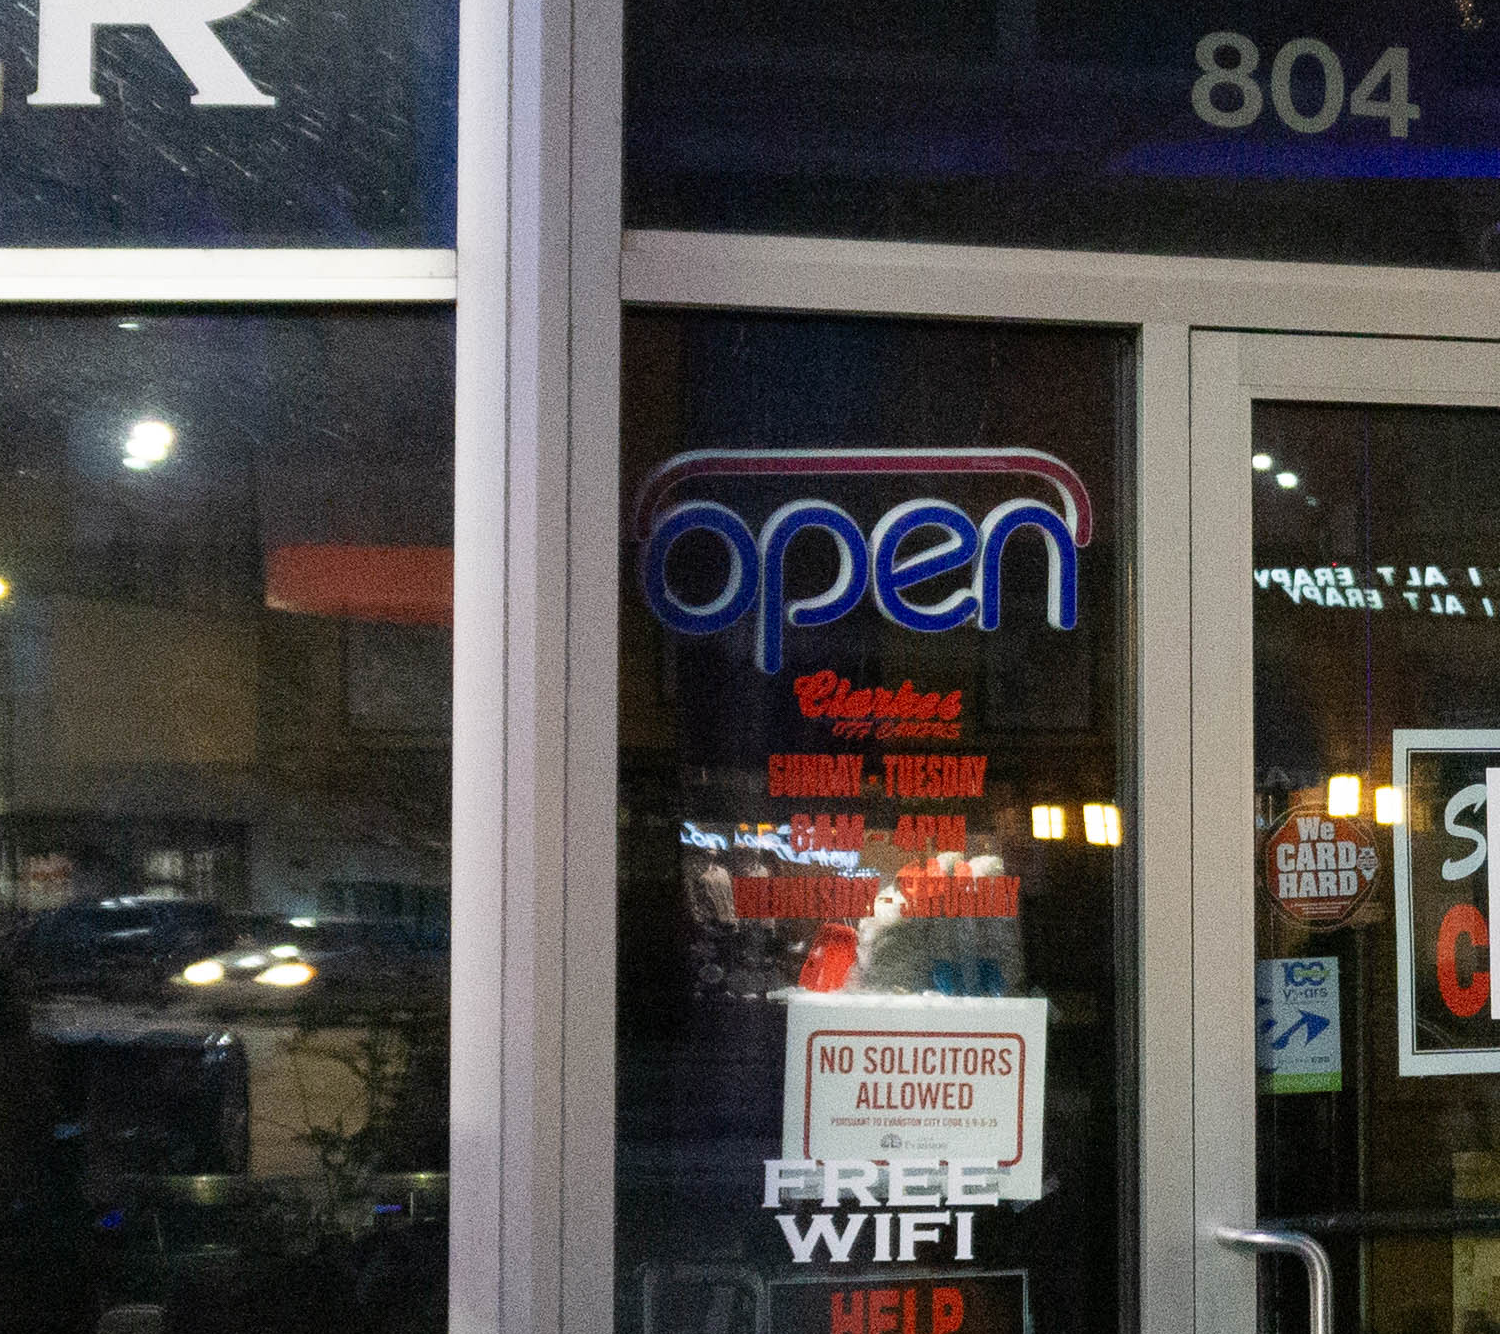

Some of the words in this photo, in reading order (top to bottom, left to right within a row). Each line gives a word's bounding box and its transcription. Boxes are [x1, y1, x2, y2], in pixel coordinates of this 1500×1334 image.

[1191, 31, 1421, 138] 804
[644, 498, 1077, 673] open
[768, 754, 863, 797] SUNDAY
[883, 754, 987, 797] TUESDAY
[1297, 817, 1335, 841] We
[1276, 841, 1357, 872] CARD
[1278, 870, 1358, 899] HARD
[819, 1045, 854, 1074] NO
[864, 1046, 1013, 1076] SOLICITORS
[856, 1081, 974, 1110] ALLOWED
[761, 1159, 999, 1207] FREE
[774, 1210, 975, 1263] WIFI
